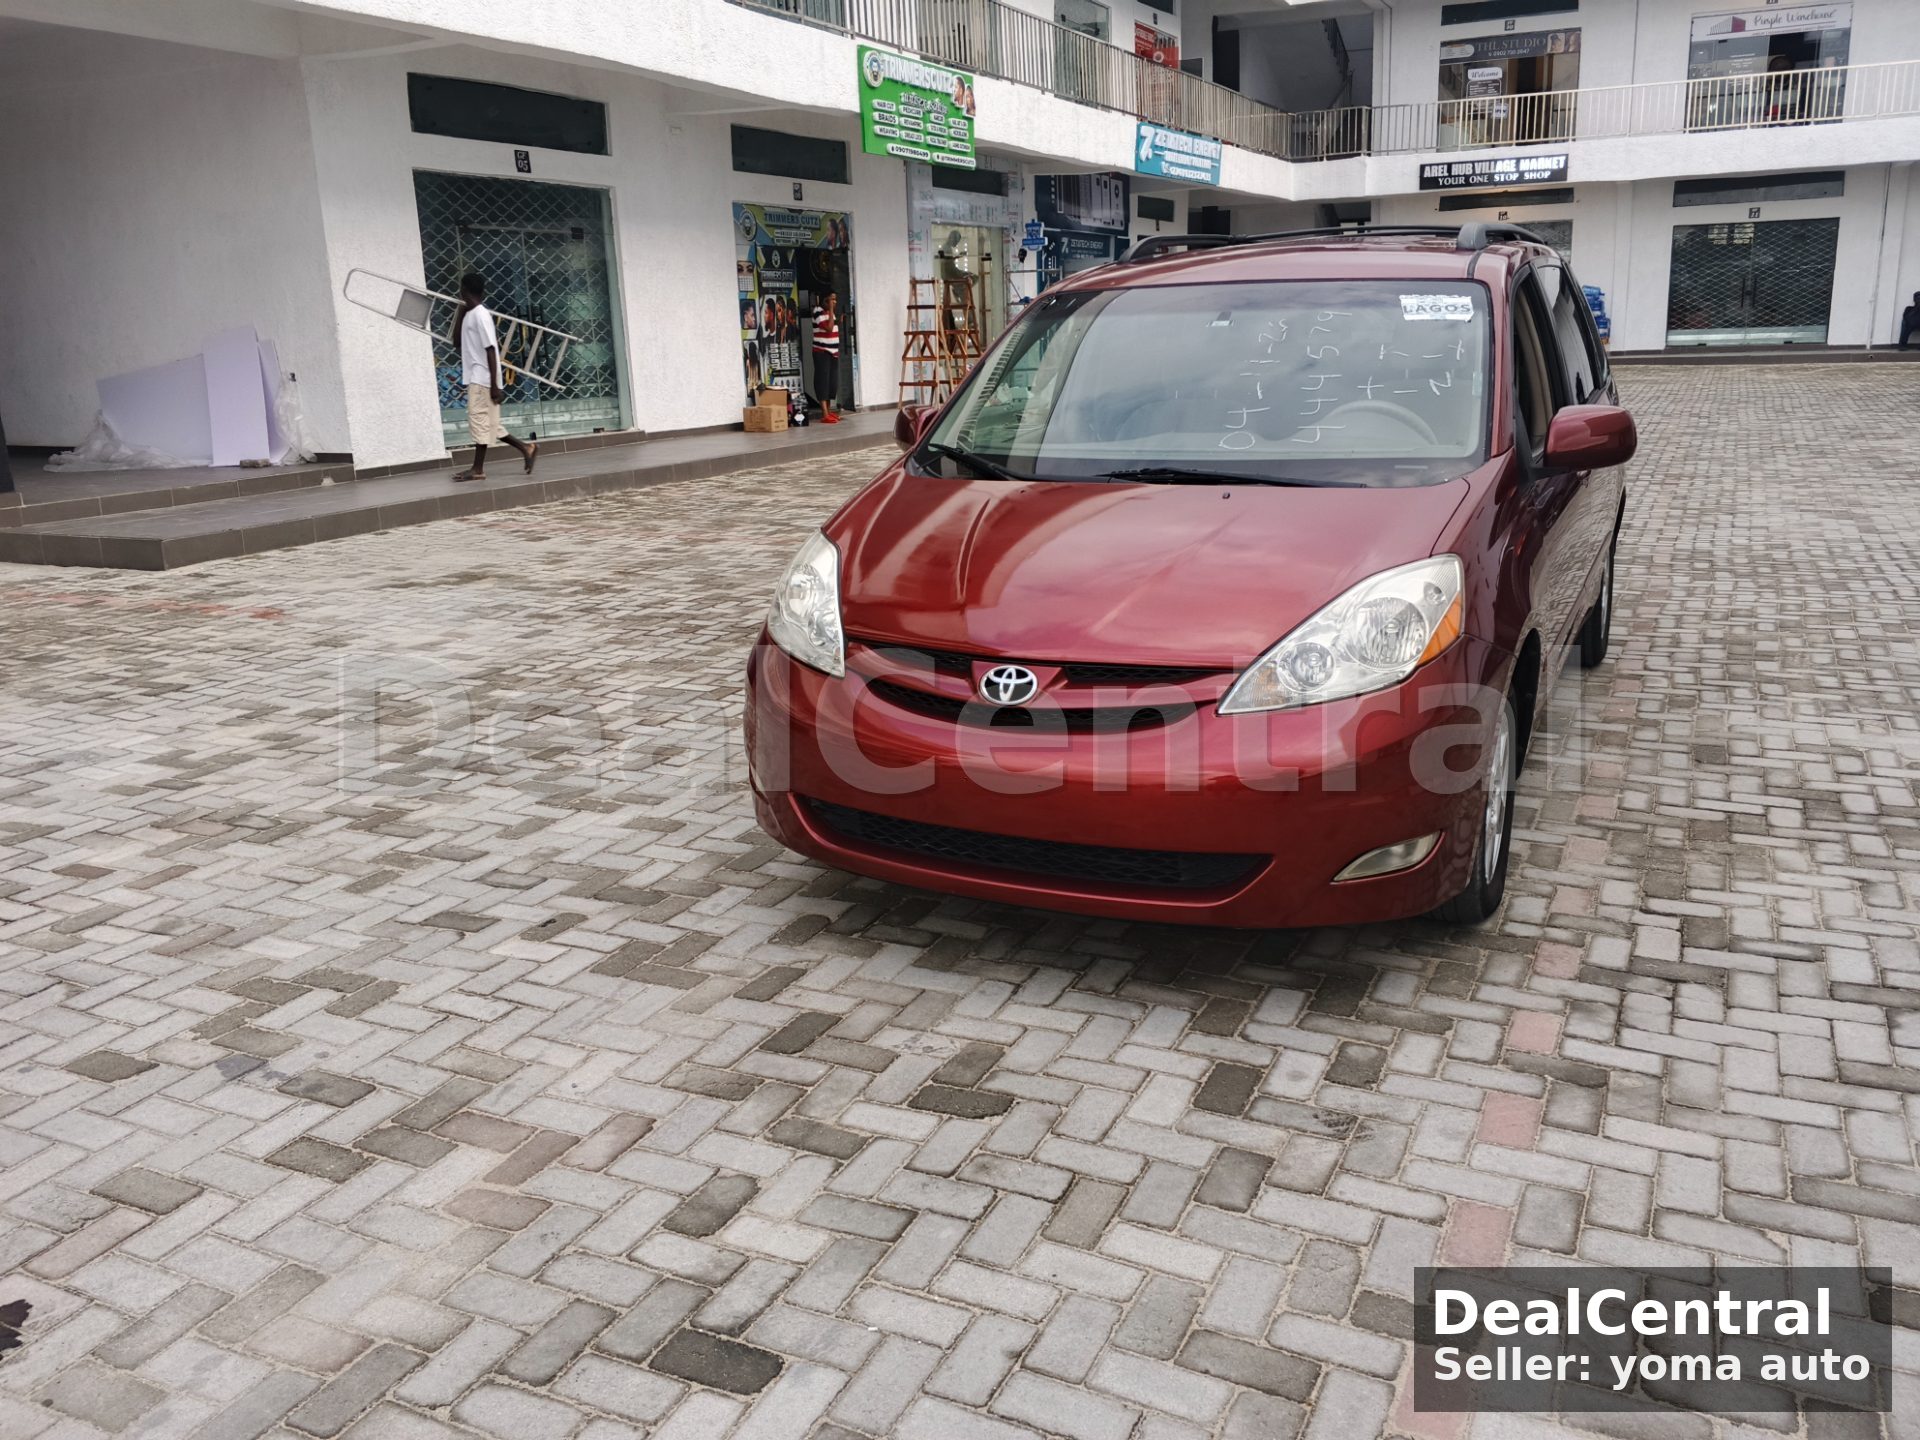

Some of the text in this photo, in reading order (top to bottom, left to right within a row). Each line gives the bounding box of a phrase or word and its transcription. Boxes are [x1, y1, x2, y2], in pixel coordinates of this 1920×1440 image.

[1754, 13, 1783, 28] Purple
[1501, 37, 1546, 50] STUDIO
[1471, 70, 1499, 79] Welcome
[878, 113, 896, 123] BRAIDS
[879, 127, 898, 136] WEAVING
[1424, 156, 1566, 178] AREL HUB VILLAGE MARKET
[1438, 170, 1551, 186] YOUR ONE STOP SHOP
[764, 212, 800, 224] TRIMMERS
[1402, 304, 1471, 314] LAGOS
